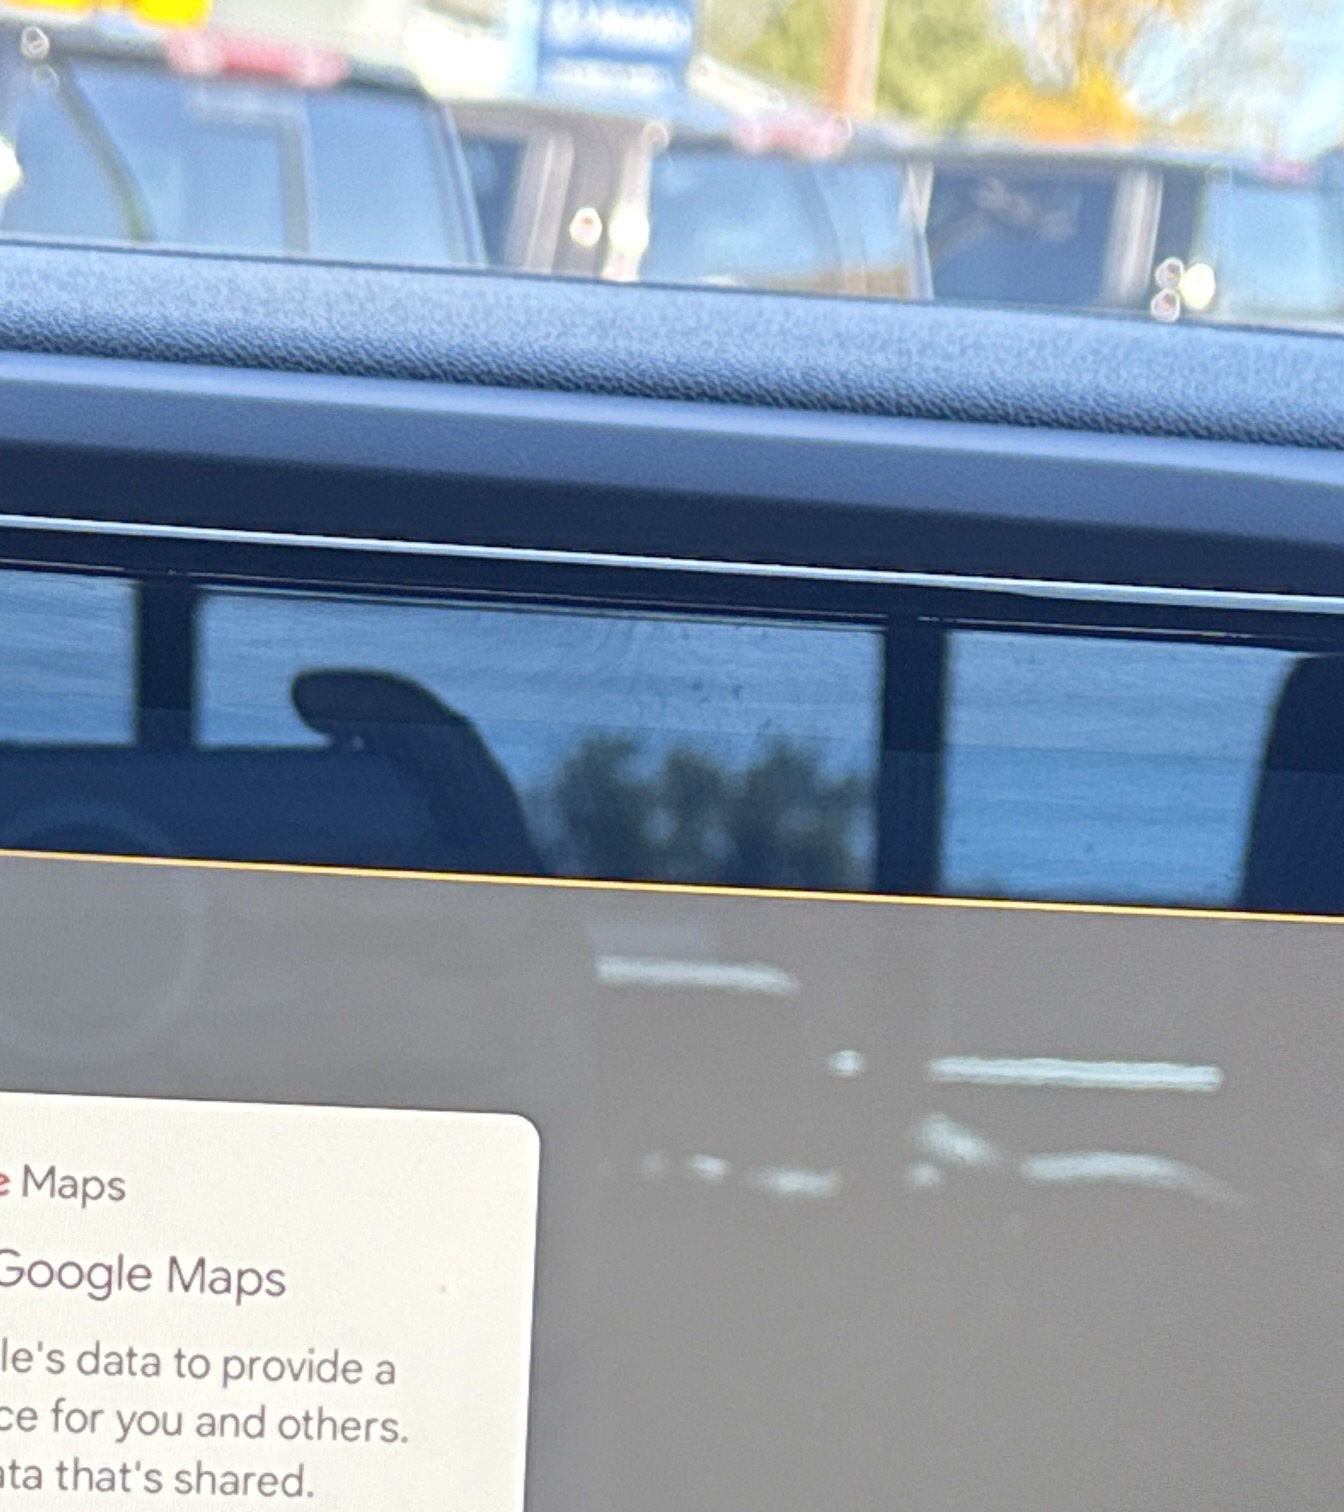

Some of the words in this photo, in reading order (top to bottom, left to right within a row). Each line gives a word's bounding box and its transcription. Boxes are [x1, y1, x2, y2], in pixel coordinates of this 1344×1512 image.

[23, 1164, 125, 1209] Maps
[168, 1256, 285, 1305] Maps
[77, 1340, 160, 1377] data
[174, 1349, 210, 1379] to
[223, 1349, 362, 1388] provide
[376, 1361, 395, 1385] a
[51, 1398, 104, 1433] for
[116, 1410, 182, 1441] you
[196, 1405, 265, 1439] and
[278, 1407, 407, 1443] others.
[56, 1457, 162, 1493] that's
[175, 1461, 313, 1497] shared.
